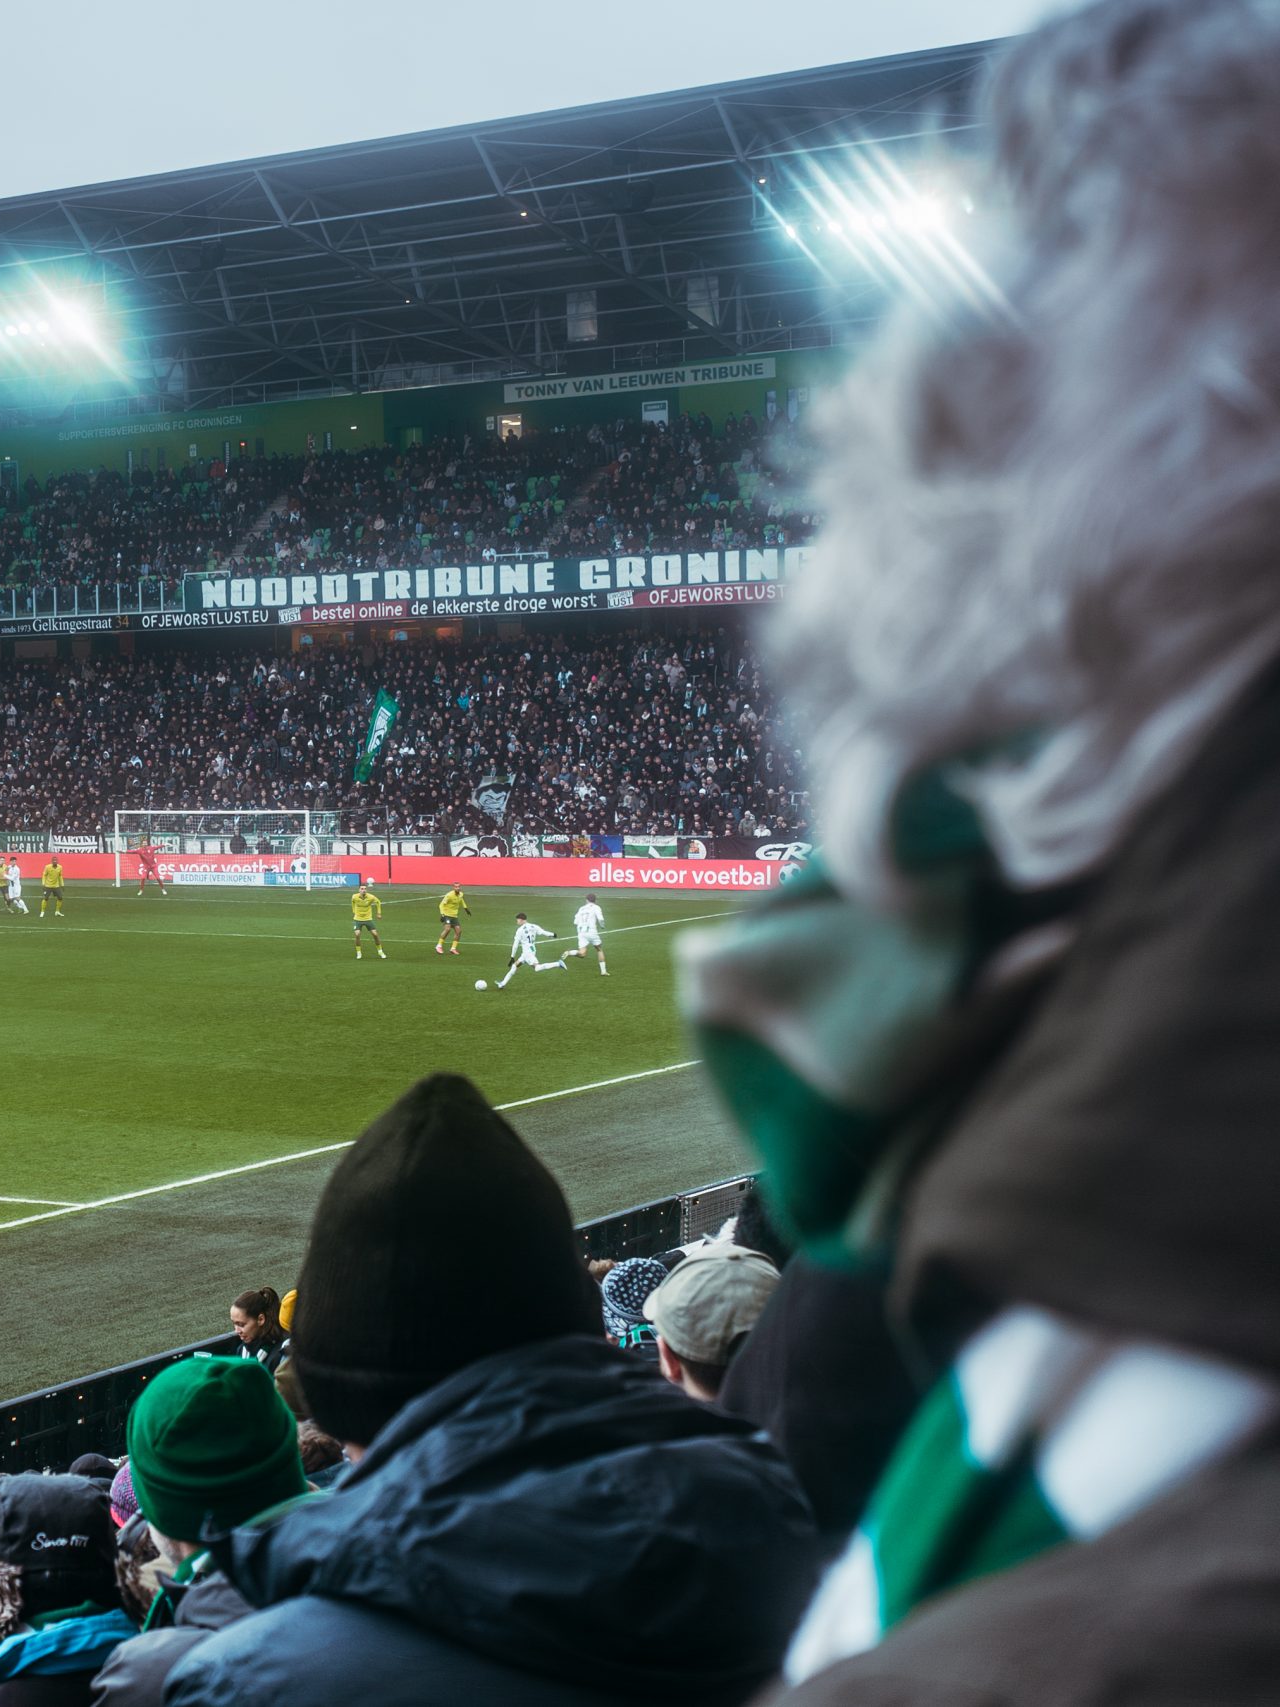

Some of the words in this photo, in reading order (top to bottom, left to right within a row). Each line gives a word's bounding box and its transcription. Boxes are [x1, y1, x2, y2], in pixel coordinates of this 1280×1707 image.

[515, 382, 568, 399] TONNY
[572, 377, 604, 393] VAN
[609, 370, 686, 390] LEEUWEN
[690, 363, 764, 382] TRIBUNE
[202, 561, 555, 609] NOORDTRIBUNE
[313, 604, 355, 620] bestel
[359, 602, 403, 618] online
[411, 601, 428, 616] de
[433, 598, 499, 616] lekkerste
[504, 596, 547, 613] droge
[552, 593, 598, 609] worst
[32, 617, 113, 634] Gelkingestraat
[115, 615, 129, 629] 34
[142, 609, 269, 628] OFJEWORSTLUST.EU
[288, 875, 347, 884] MAKTLINK
[588, 862, 635, 883] alles
[640, 867, 687, 884] voor
[691, 864, 771, 885] voetbal
